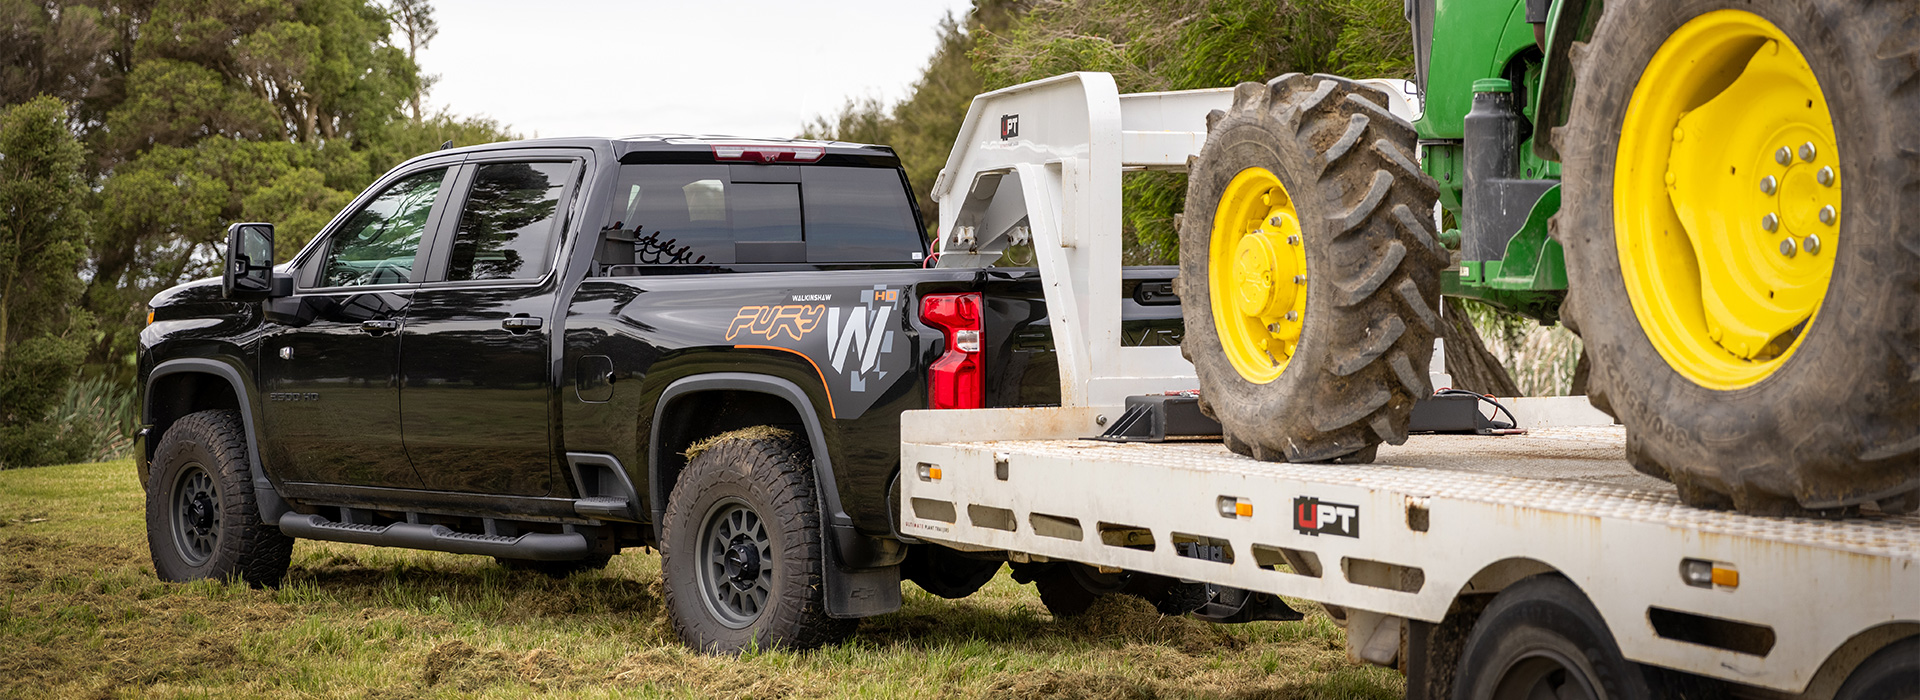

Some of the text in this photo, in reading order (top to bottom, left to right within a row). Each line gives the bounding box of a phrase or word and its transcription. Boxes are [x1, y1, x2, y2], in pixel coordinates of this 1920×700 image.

[1002, 117, 1018, 136] UPT
[792, 294, 832, 302] WALKINSHAW
[874, 290, 897, 301] HD
[725, 304, 826, 341] FURY
[302, 392, 319, 401] HD
[1298, 503, 1356, 534] UPT
